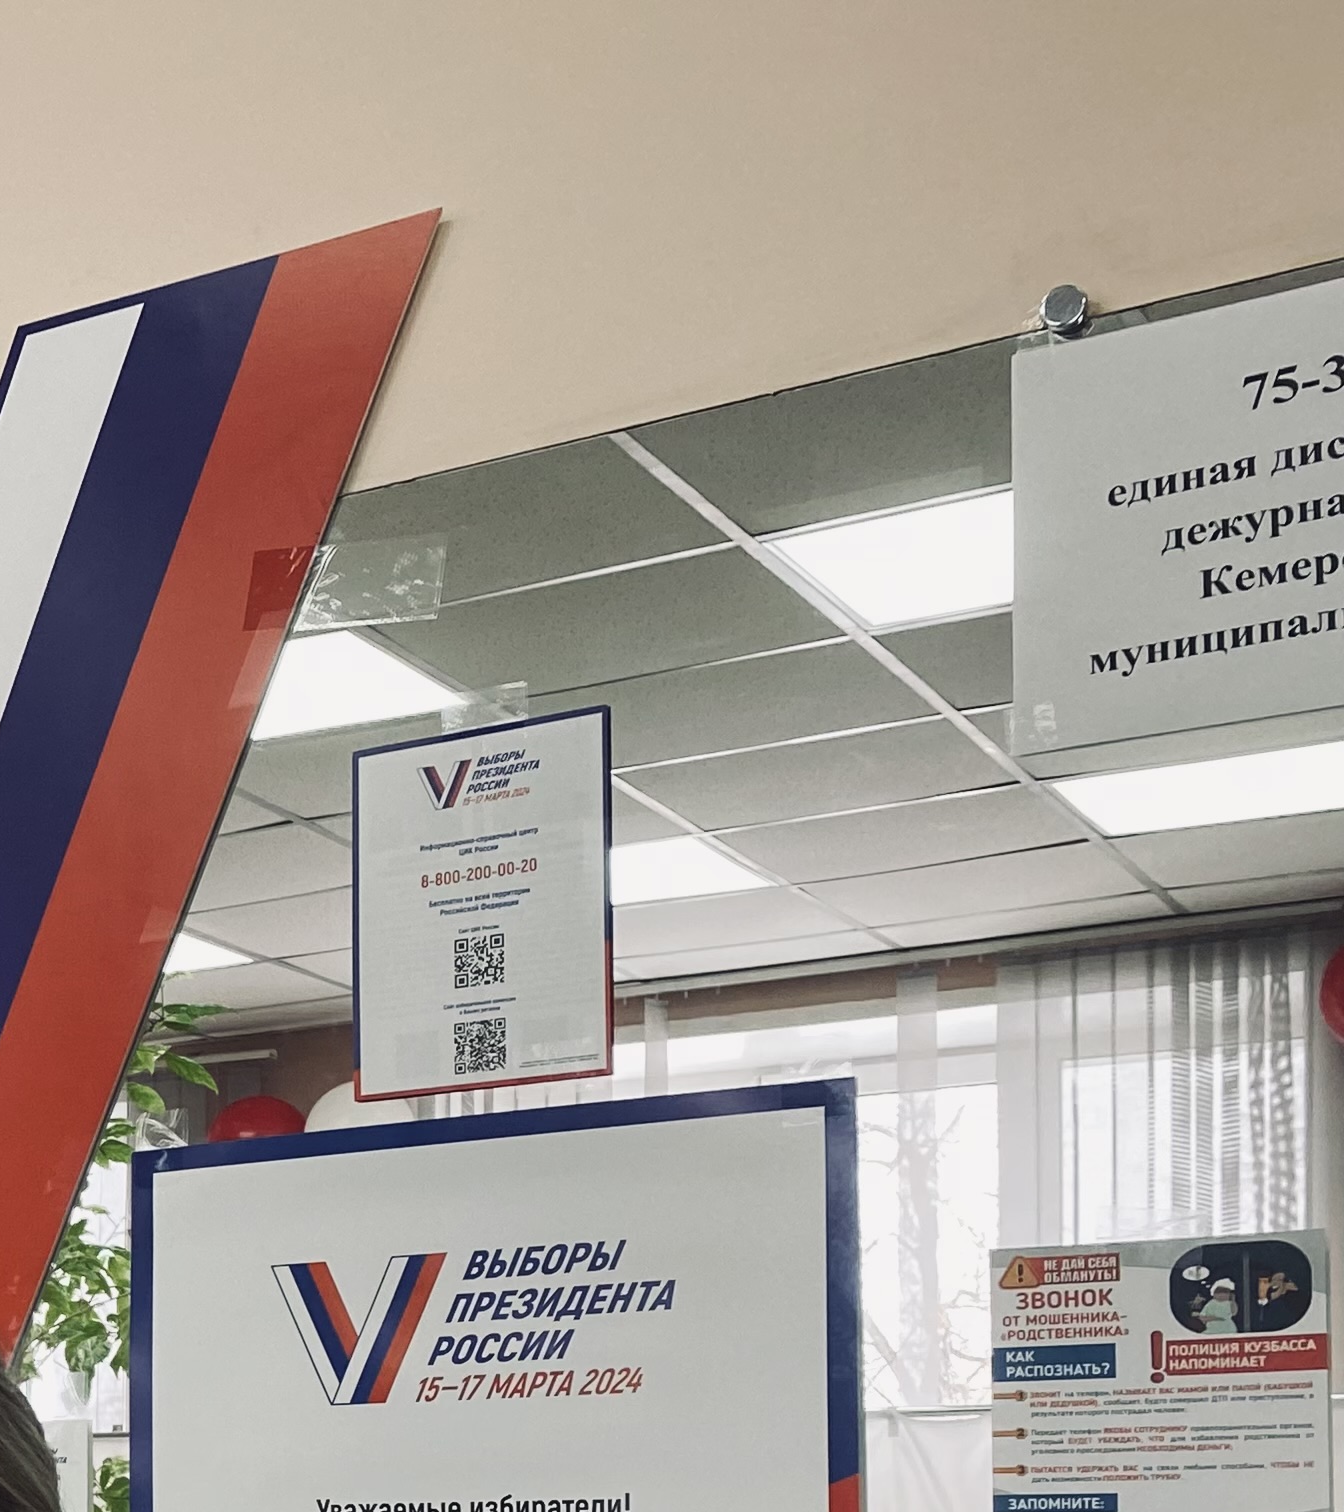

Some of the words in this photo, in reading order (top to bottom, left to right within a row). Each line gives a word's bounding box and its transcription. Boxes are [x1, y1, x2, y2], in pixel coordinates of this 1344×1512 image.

[1108, 455, 1256, 508] единая
[477, 749, 526, 767] ВЫБОРЫ
[472, 759, 540, 781] ПРЕЗИДЕНТА
[466, 778, 510, 794] РОССИИ
[484, 791, 510, 803] МАРТА
[512, 787, 530, 798] 2024
[475, 845, 499, 854] России
[421, 858, 537, 888] 8-800-200-00-20
[429, 896, 463, 908] Бесплатно
[475, 892, 490, 901] всей
[492, 888, 531, 899] территории
[440, 904, 479, 916] Российской
[481, 900, 519, 911] Федерации
[463, 1239, 627, 1281] ВЫБОРЫ
[1044, 1260, 1057, 1270] НЕ
[1062, 1257, 1085, 1270] ДАЙ
[1088, 1256, 1117, 1268] СЕБЯ
[1044, 1269, 1117, 1283] ОБМАНУТЬ!
[445, 1279, 677, 1323] ПРЕЗИДЕНТА
[1016, 1288, 1113, 1310] ЗВОНОК
[1002, 1315, 1020, 1327] ОТ
[427, 1329, 576, 1366] РОССИИ
[1169, 1342, 1239, 1356] ПОЛИЦИЯ
[1244, 1338, 1317, 1353] КУЗБАССА
[1006, 1351, 1035, 1362] КАК
[1169, 1355, 1267, 1370] НАПОМИНАЕТ
[1006, 1363, 1110, 1378] РАСПОЗНАТЬ?
[487, 1371, 573, 1401] МАРТА
[579, 1367, 644, 1397] 2024
[1008, 1497, 1105, 1510] ЗАПОМНИТЕ:
